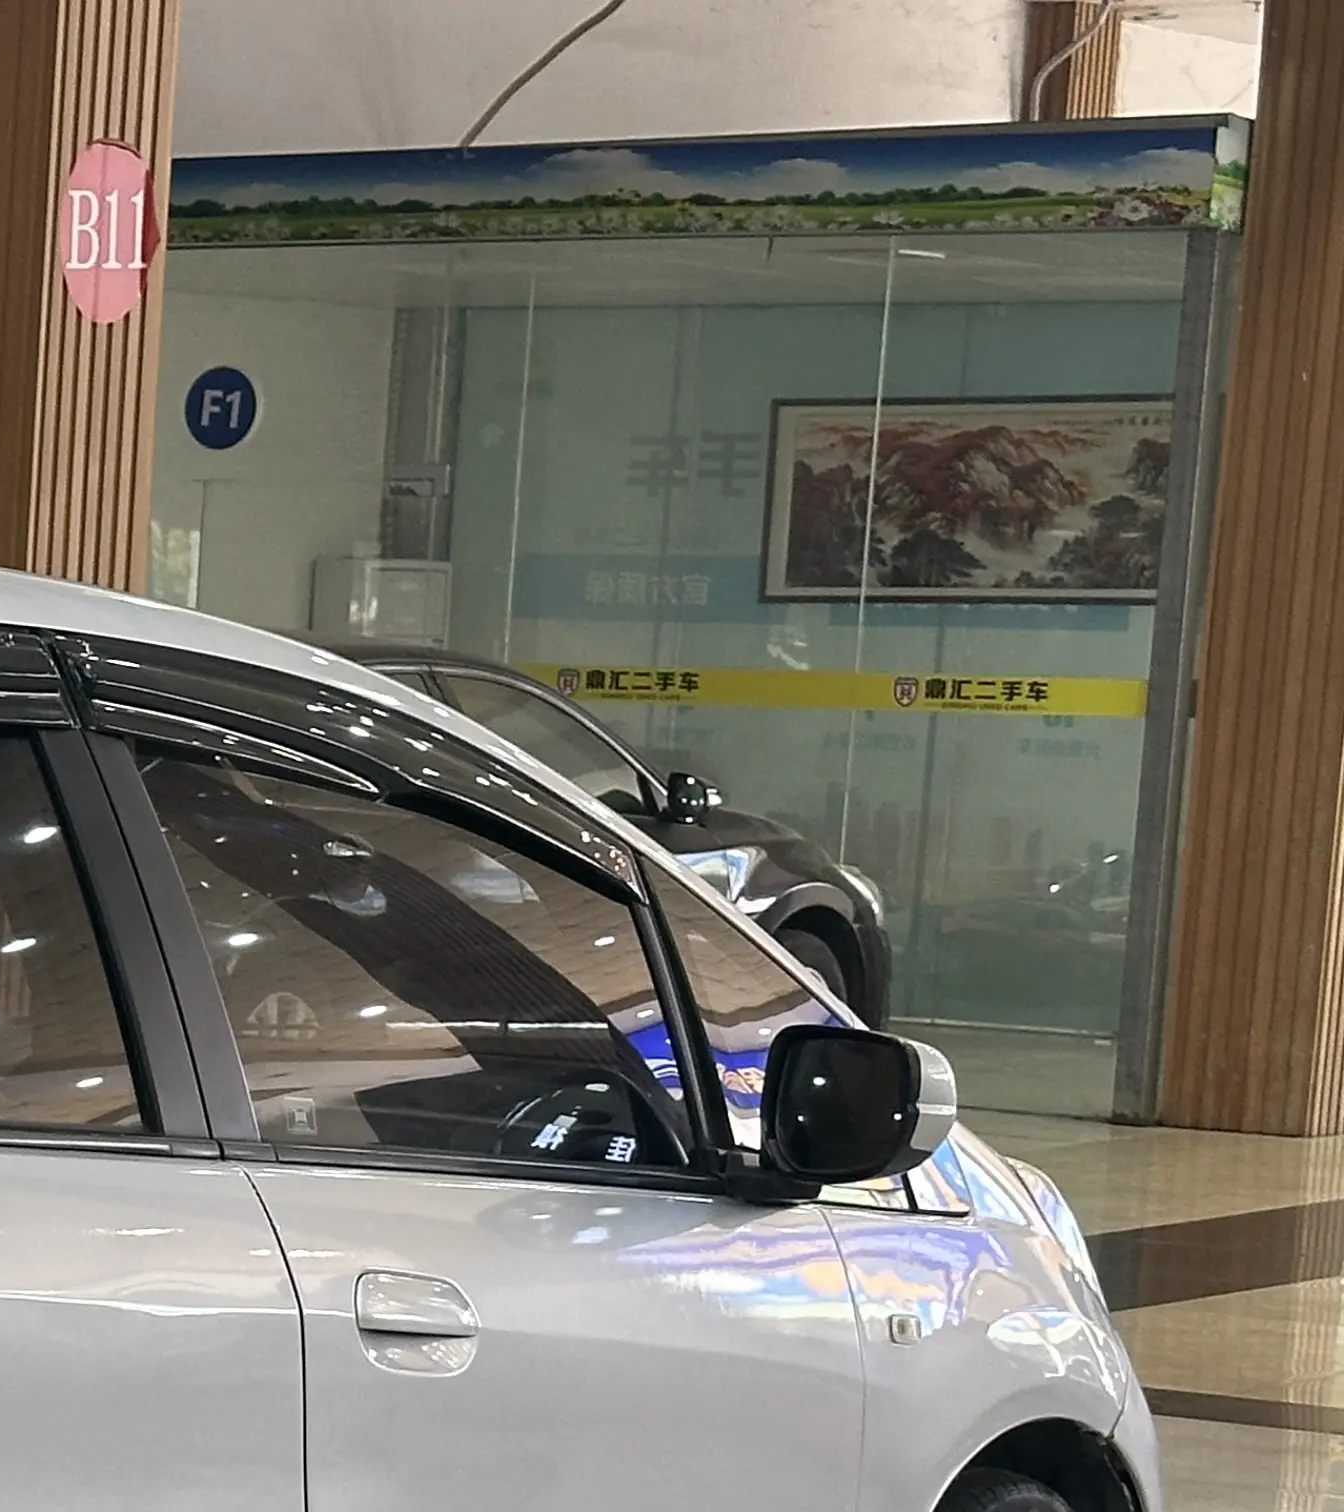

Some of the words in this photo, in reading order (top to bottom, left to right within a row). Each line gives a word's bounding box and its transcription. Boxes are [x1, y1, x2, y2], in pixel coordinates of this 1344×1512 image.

[66, 188, 148, 270] B11
[200, 389, 242, 428] F1
[585, 669, 700, 693] 鼎汇二手车
[924, 677, 1050, 702] 鼎汇二手车
